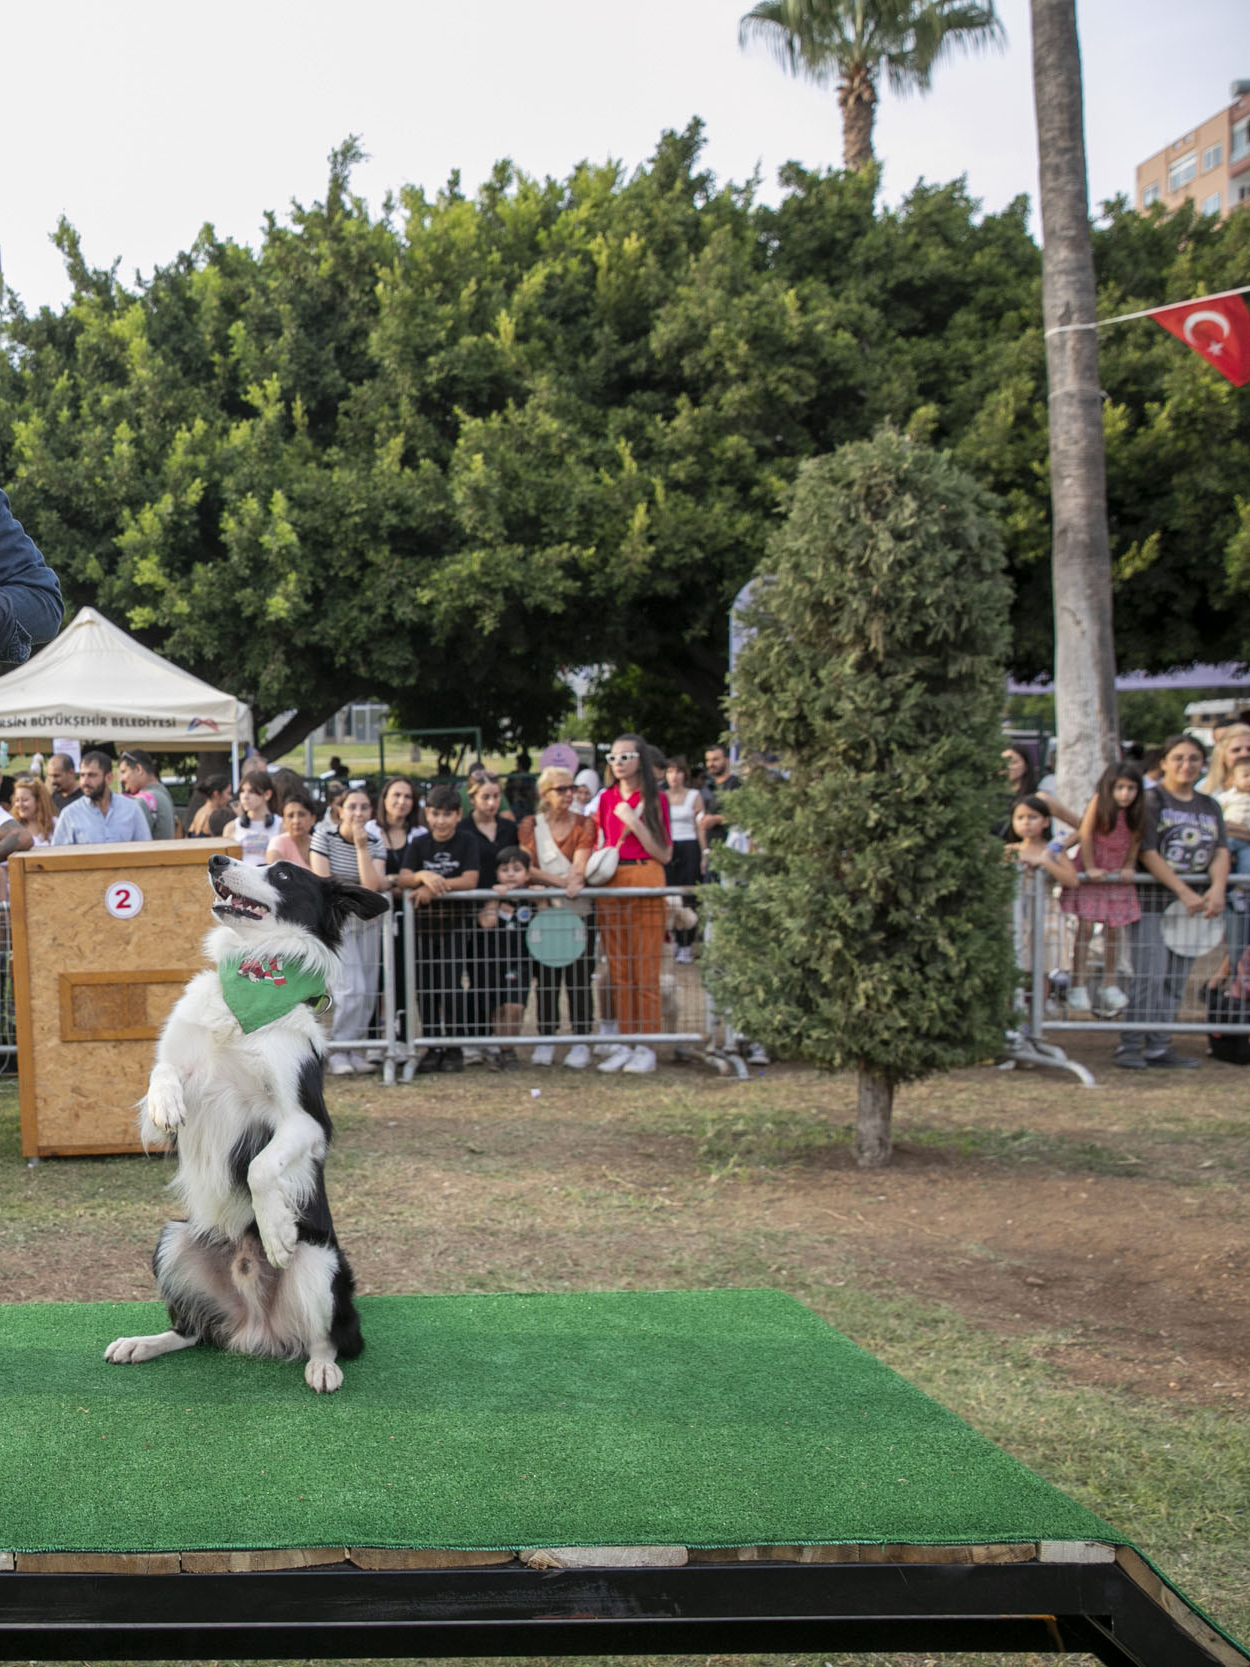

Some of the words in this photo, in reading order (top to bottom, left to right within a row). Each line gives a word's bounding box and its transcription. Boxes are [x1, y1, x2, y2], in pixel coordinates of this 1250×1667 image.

[30, 712, 107, 730] BÜYÜKŞEHİR
[111, 715, 176, 728] BELEDİYESİ
[115, 889, 132, 909] 2
